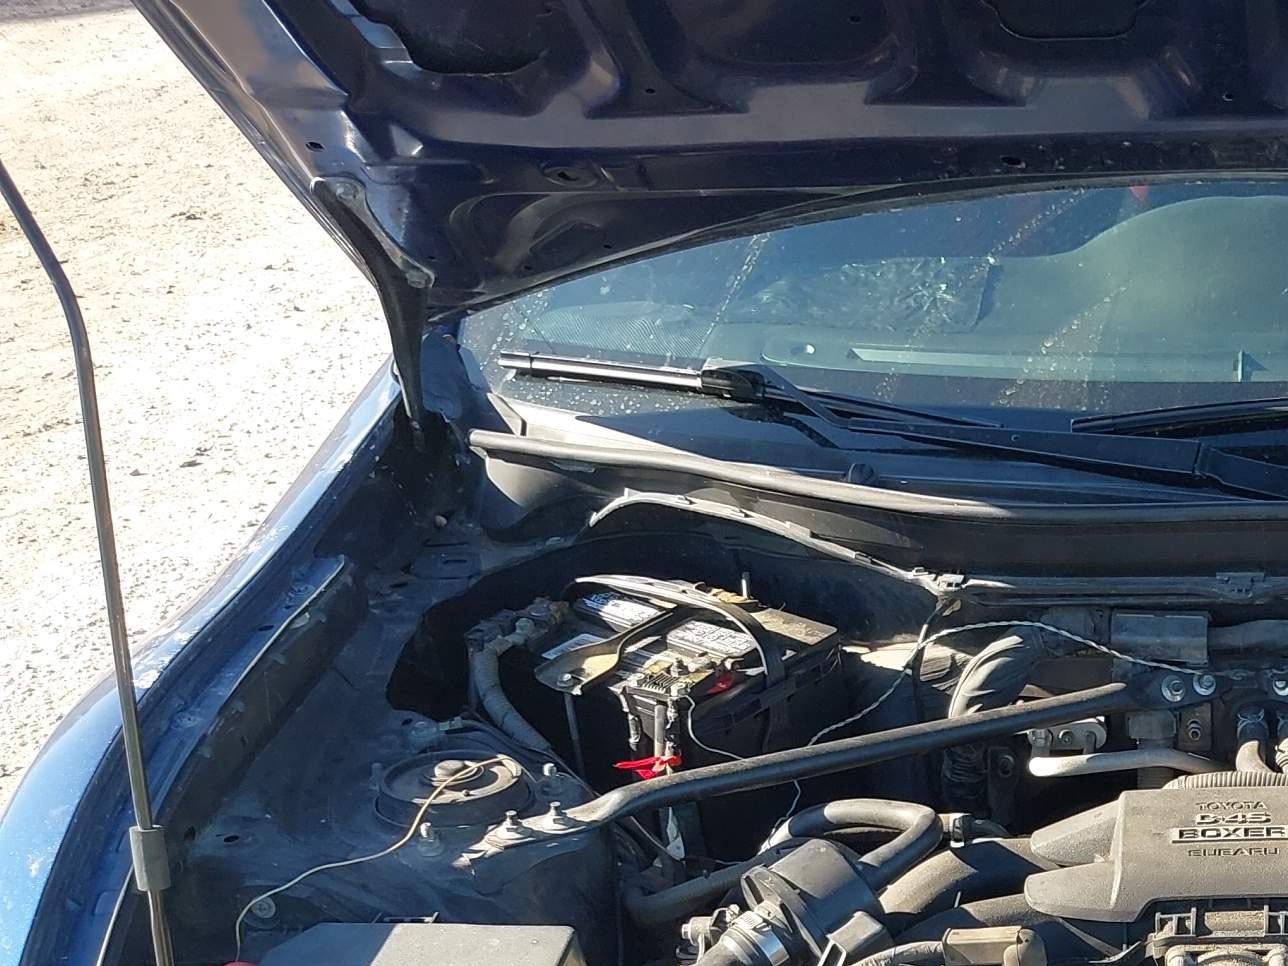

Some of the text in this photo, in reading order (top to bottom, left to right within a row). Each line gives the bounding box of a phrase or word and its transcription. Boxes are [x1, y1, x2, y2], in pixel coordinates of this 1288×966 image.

[1195, 801, 1268, 811] TOYOTA
[1178, 827, 1286, 839] BOXER
[1187, 847, 1280, 857] SUBARU
